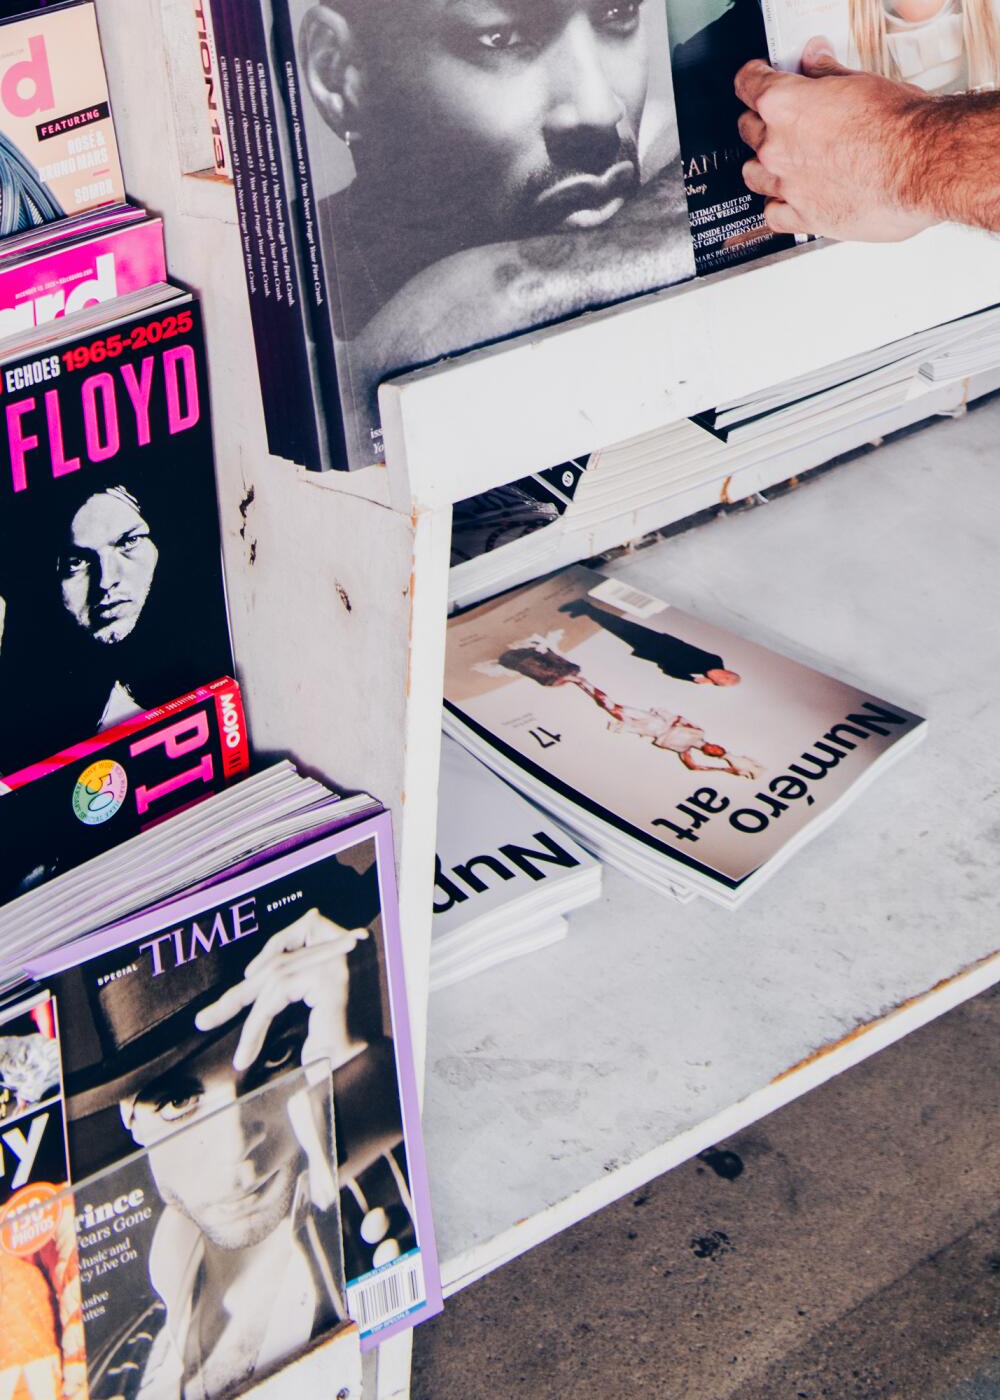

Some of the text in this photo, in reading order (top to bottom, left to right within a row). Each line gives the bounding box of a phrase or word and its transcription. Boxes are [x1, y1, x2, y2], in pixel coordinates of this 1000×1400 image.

[41, 109, 101, 137] FEATURING
[264, 124, 276, 161] Obsession
[293, 123, 304, 159] Obsession
[76, 149, 109, 173] MARS
[298, 160, 306, 174] #23
[272, 184, 281, 197] You
[300, 183, 309, 196] You
[274, 199, 285, 221] Never
[302, 198, 313, 220] Never
[716, 202, 750, 220] WEEKEND
[722, 194, 752, 210] SUIT FOR
[276, 222, 287, 246] Forget
[304, 221, 316, 244] Forget
[697, 216, 757, 241] INSIDE LONDON'S
[703, 225, 751, 246] GENTLEMEN'S
[280, 247, 290, 264] Your
[308, 245, 318, 263] Your
[715, 240, 747, 256] PIGUET'S
[746, 231, 775, 246] HISTORY
[283, 266, 292, 282] First
[311, 264, 320, 281] First
[285, 283, 296, 307] Crush.
[312, 282, 324, 307] Crush.
[6, 311, 194, 393] ECHOES 1965-2025
[6, 344, 201, 493] FLOYD
[220, 693, 241, 749] MOJO
[651, 701, 907, 843] Numéro art
[97, 890, 304, 986] SPECIAL TIME EDITION
[113, 1207, 152, 1232] Gone
[109, 1237, 131, 1257] and
[95, 1258, 119, 1276] Live
[120, 1249, 138, 1263] On
